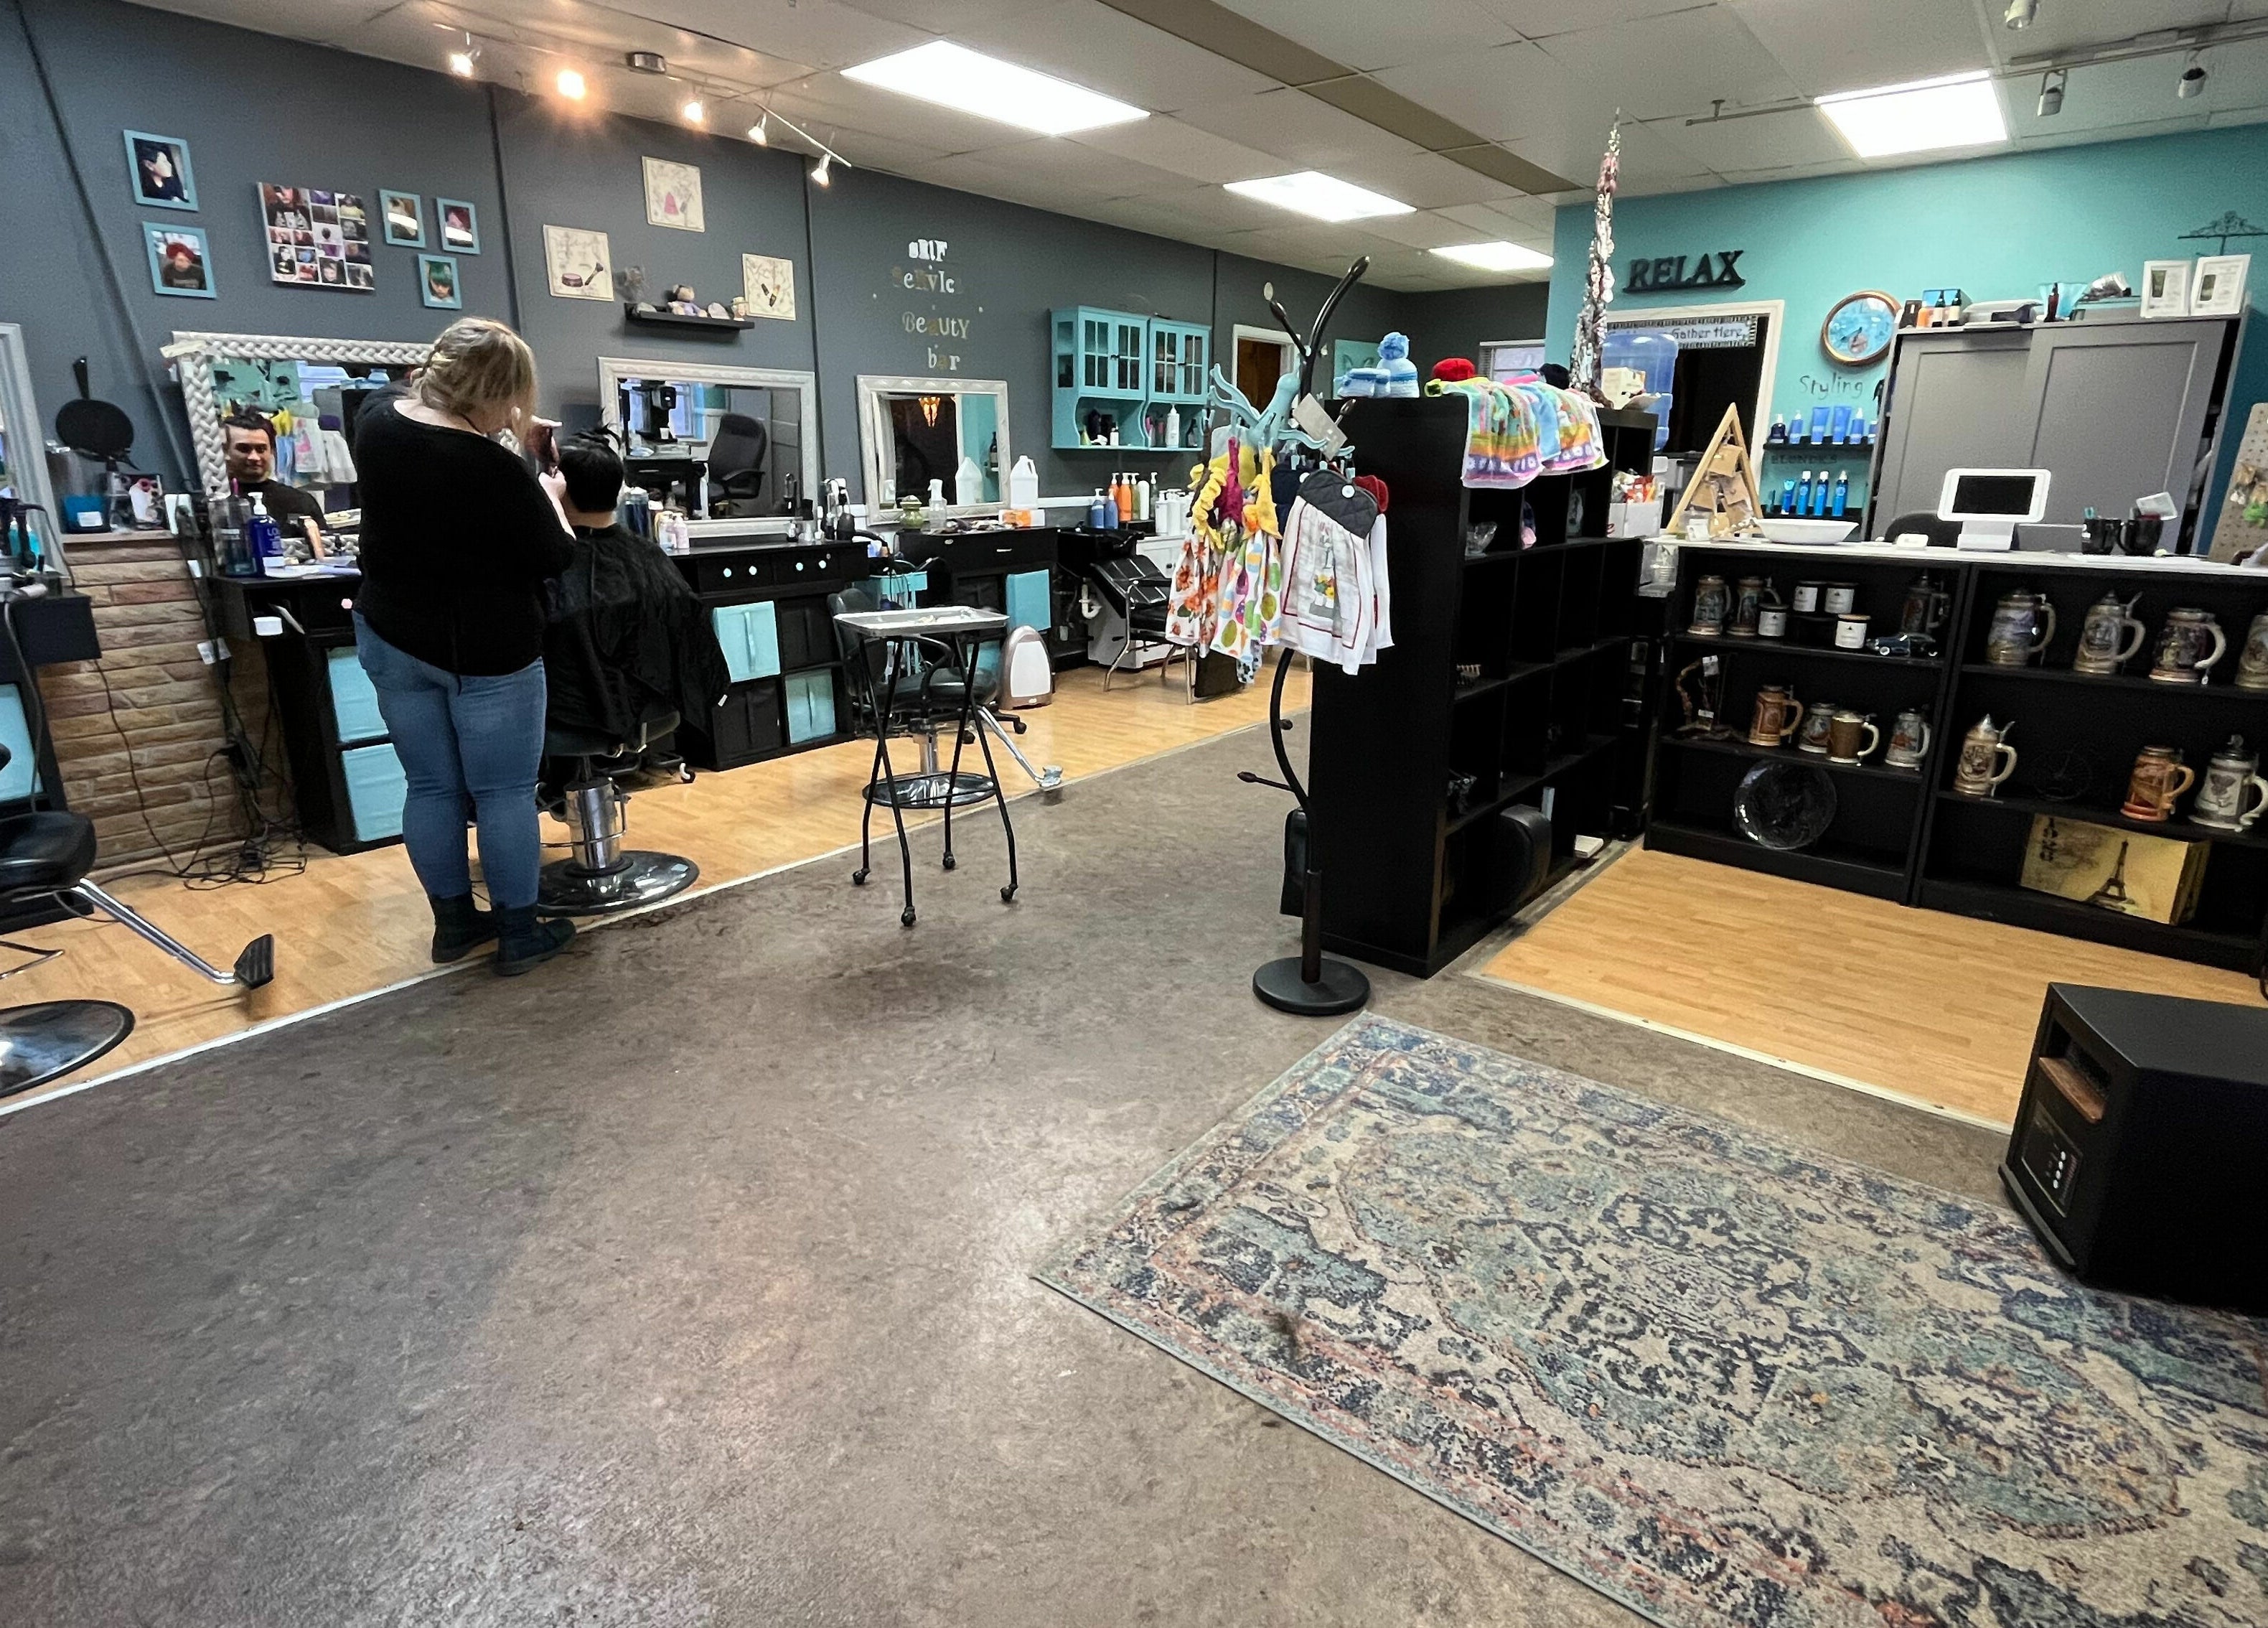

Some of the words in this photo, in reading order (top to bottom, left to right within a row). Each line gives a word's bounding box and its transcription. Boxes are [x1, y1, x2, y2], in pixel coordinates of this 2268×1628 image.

[1627, 250, 1745, 290] RELAX
[1671, 328, 1711, 340] Gather
[1799, 372, 1864, 400] Styling
